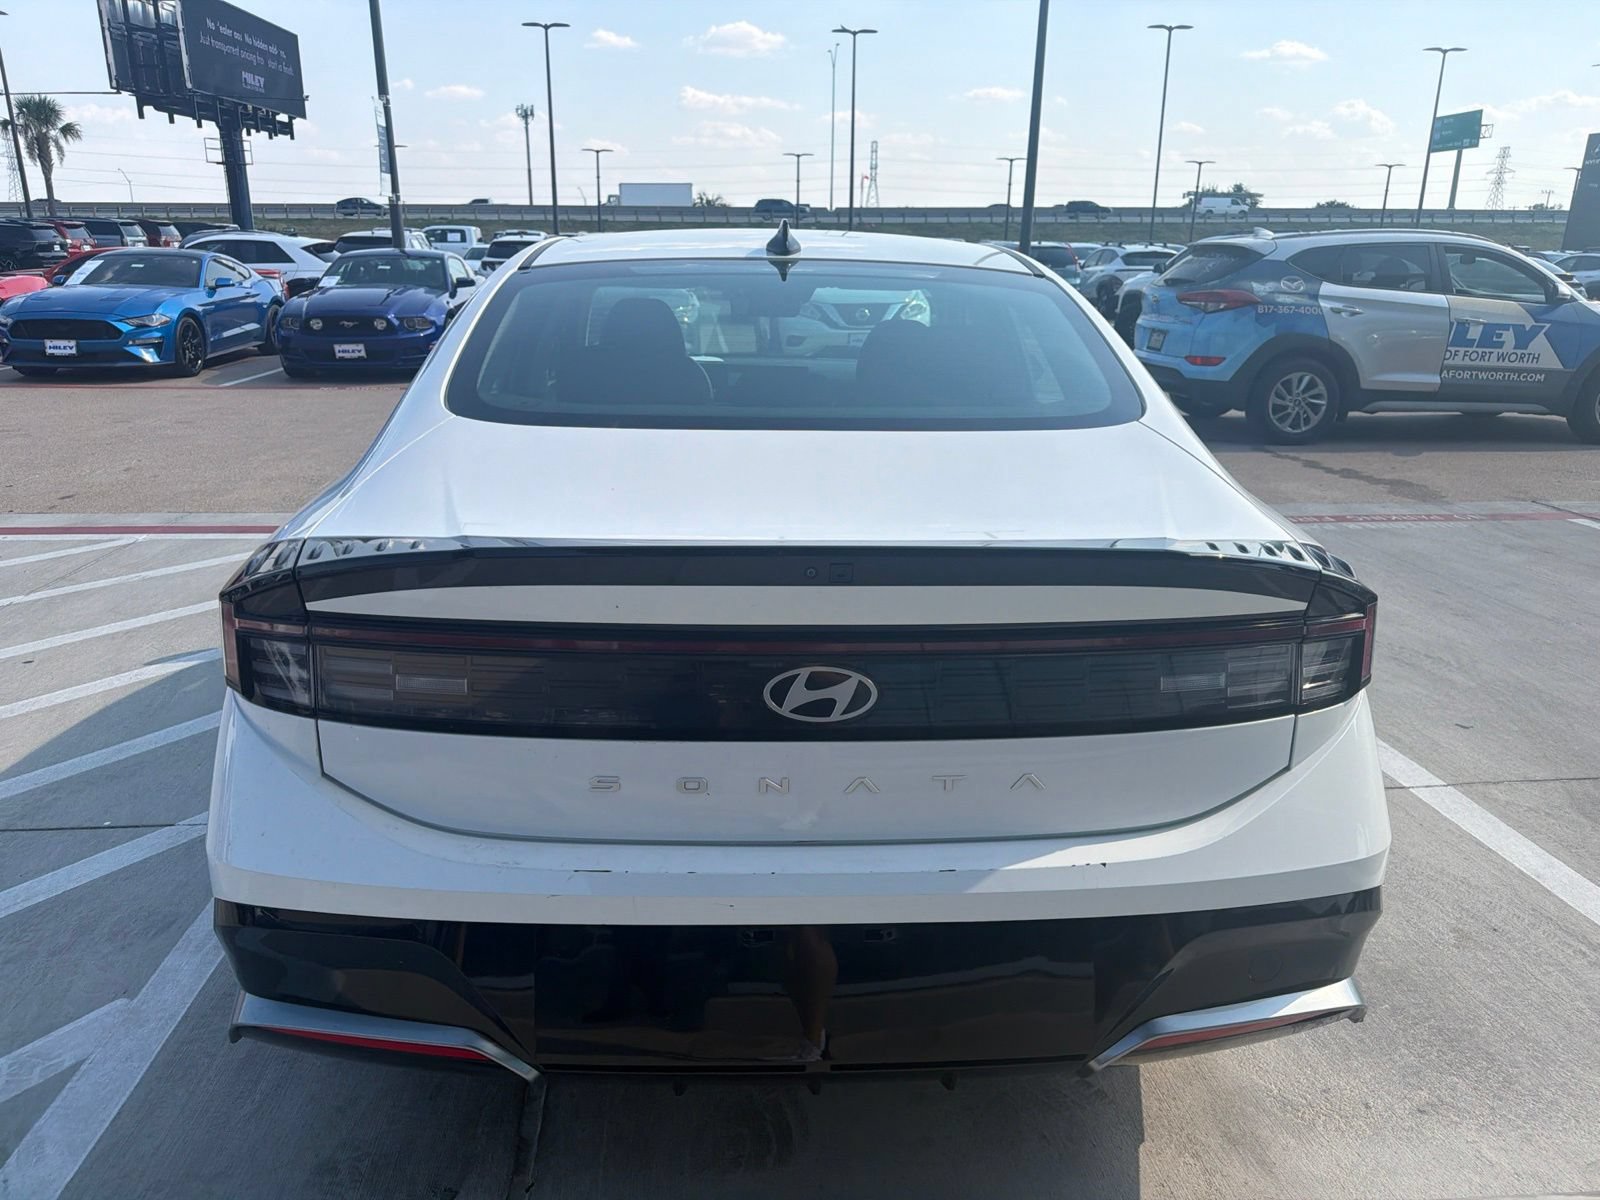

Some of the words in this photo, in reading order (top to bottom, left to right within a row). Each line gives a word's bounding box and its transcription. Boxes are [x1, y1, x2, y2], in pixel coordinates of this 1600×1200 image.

[206, 17, 215, 30] No
[244, 32, 252, 45] No
[241, 70, 265, 88] HILEY
[1444, 349, 1461, 361] OF
[1462, 350, 1494, 363] FORT
[1496, 351, 1541, 365] WORTH
[588, 772, 1047, 794] SONATA
